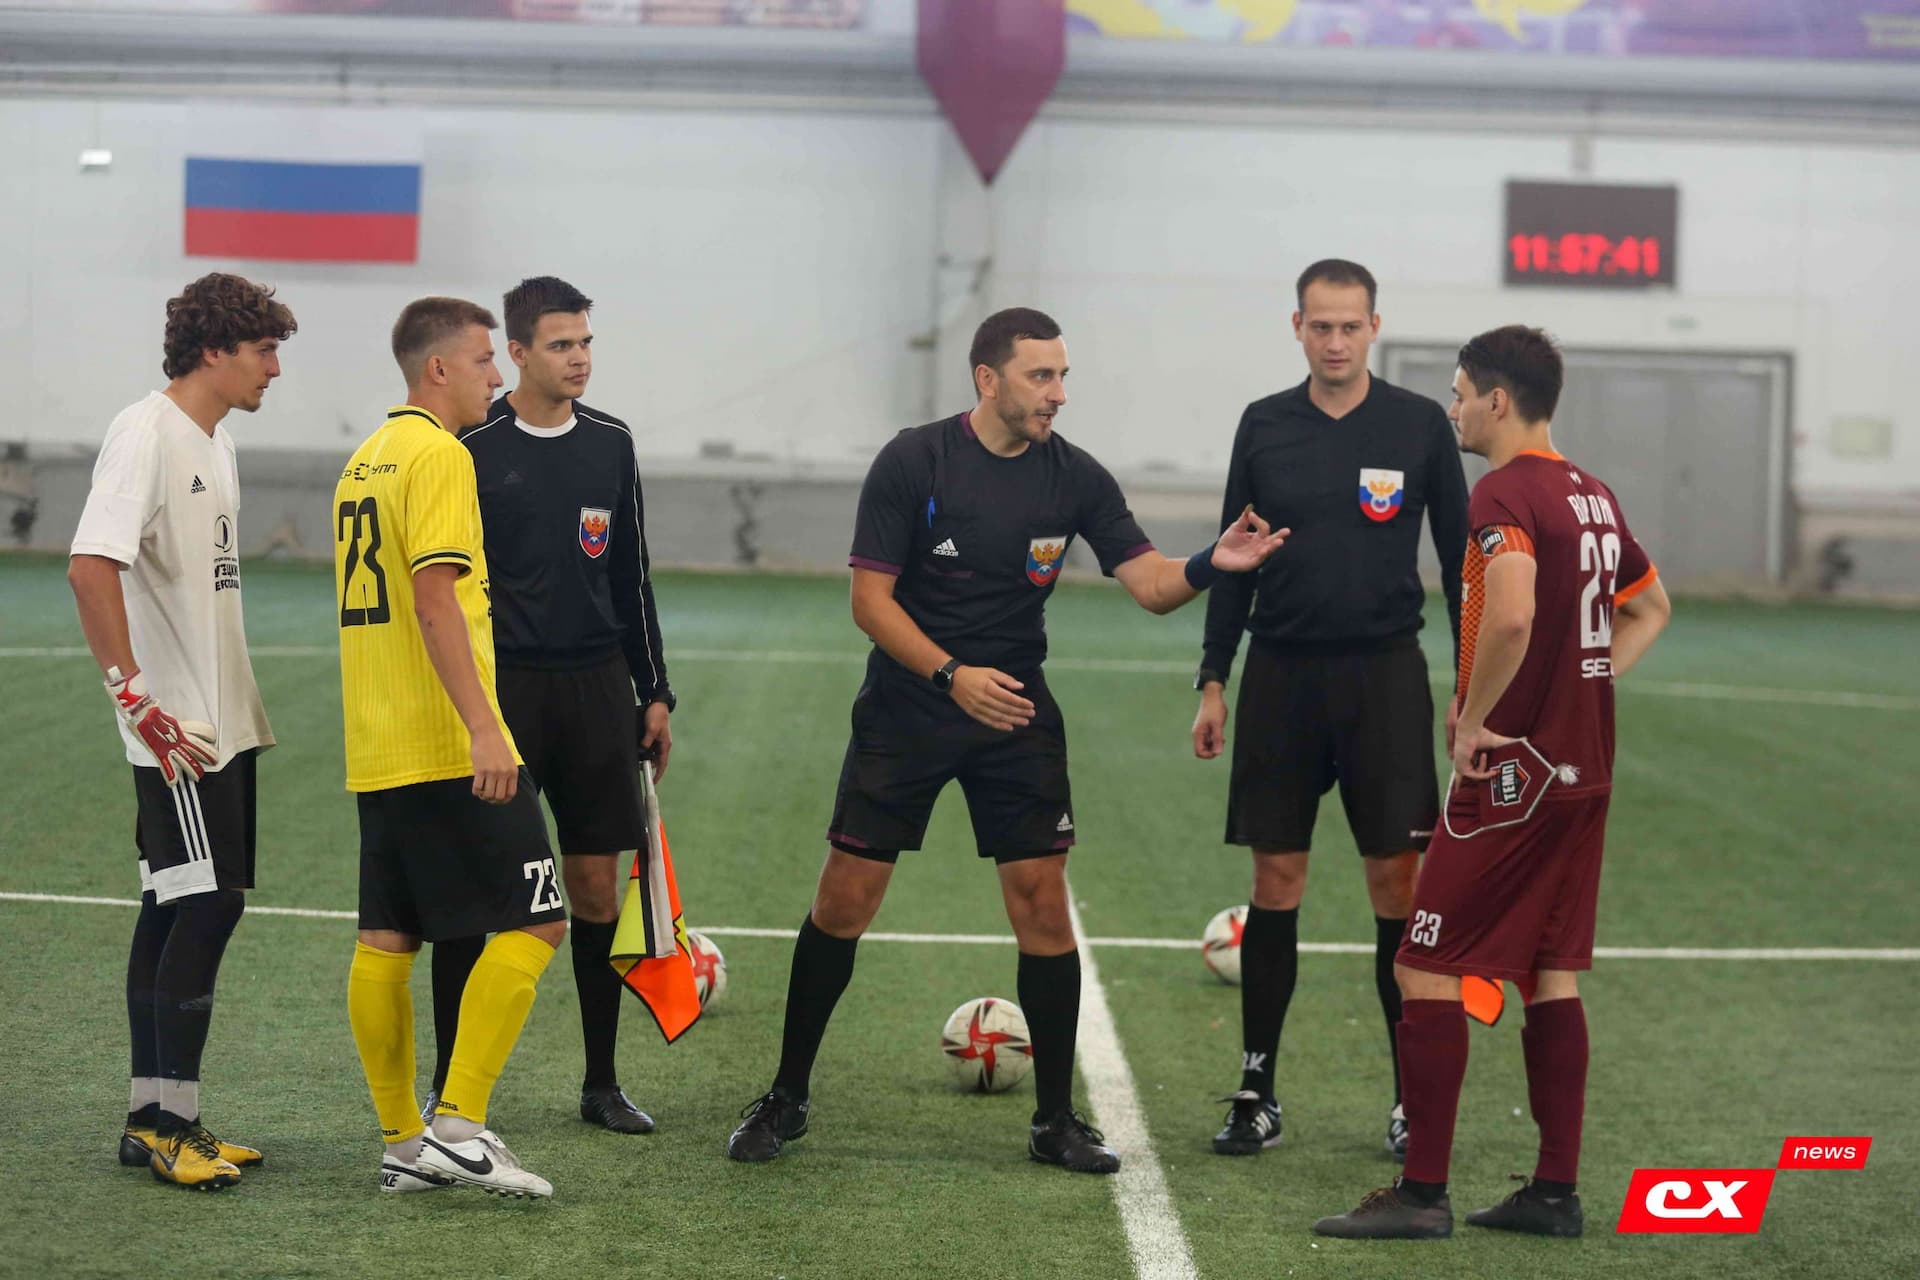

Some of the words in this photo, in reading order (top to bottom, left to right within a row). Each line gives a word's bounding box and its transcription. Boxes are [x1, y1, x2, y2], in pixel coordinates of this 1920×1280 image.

[338, 497, 390, 628] 23
[1502, 764, 1517, 802] ТЕМП
[523, 858, 563, 913] 23
[1410, 909, 1442, 947] 23
